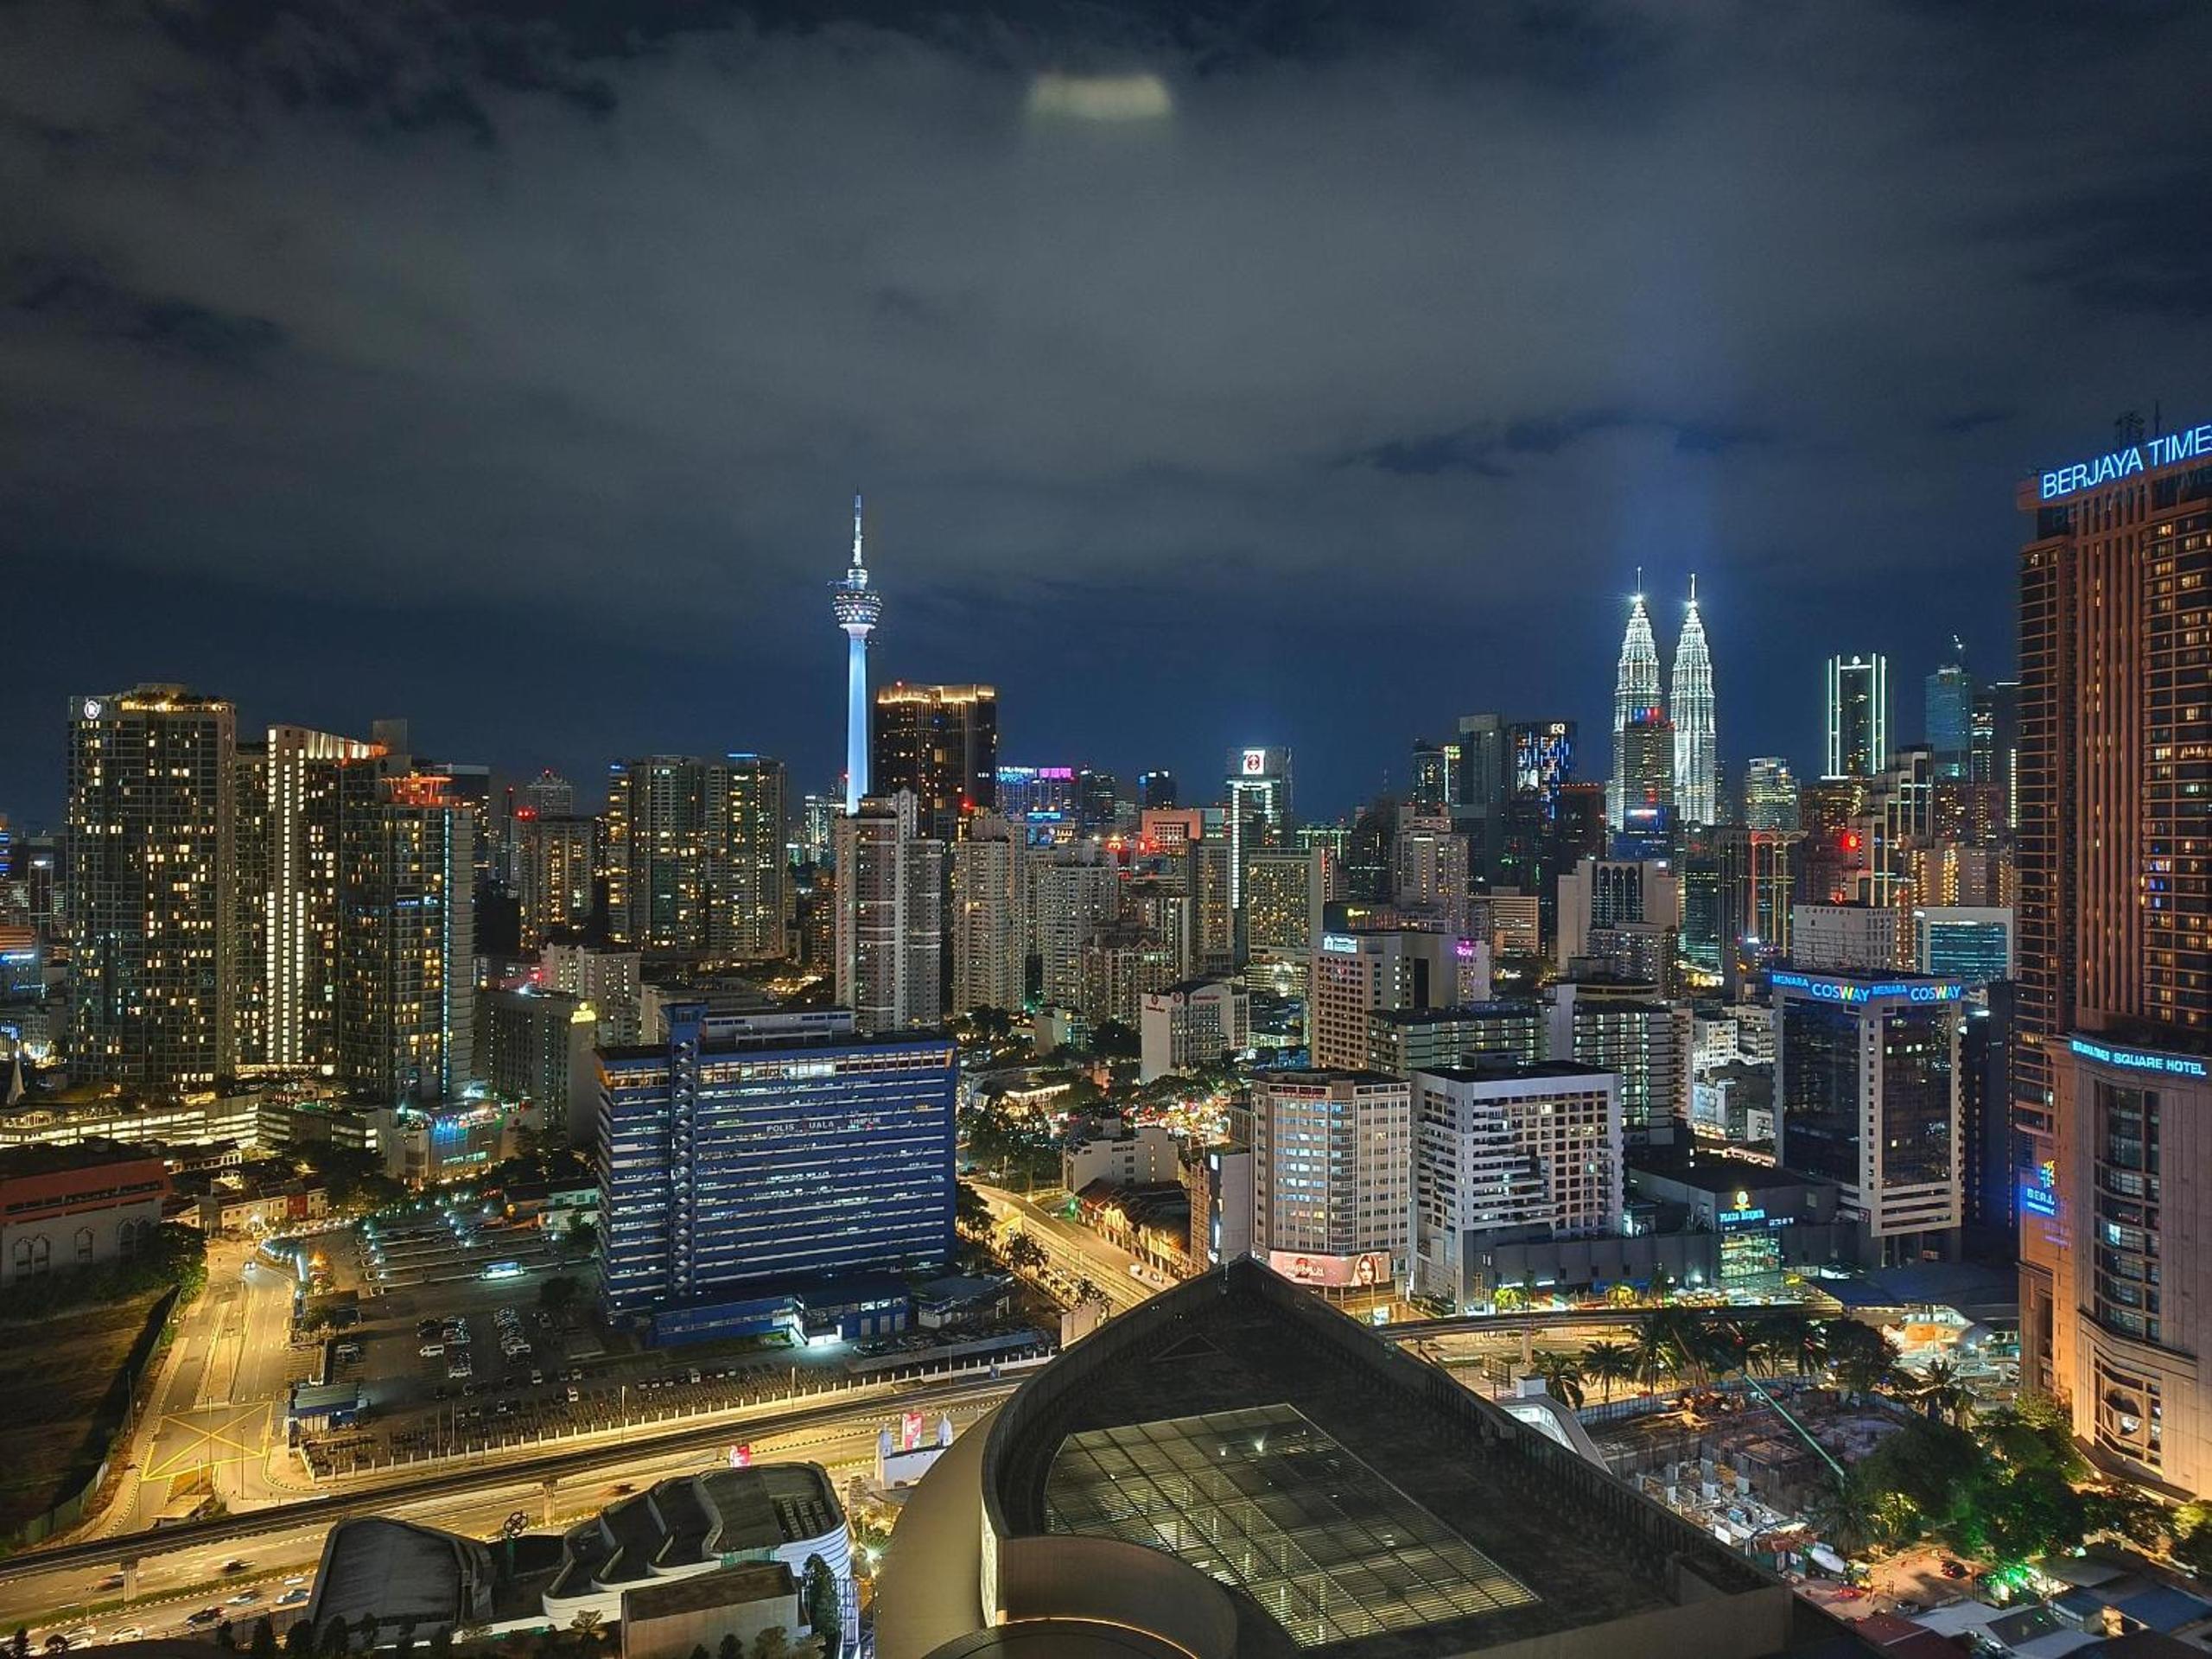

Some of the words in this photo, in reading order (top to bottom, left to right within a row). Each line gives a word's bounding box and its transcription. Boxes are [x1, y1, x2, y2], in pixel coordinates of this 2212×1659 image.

[2043, 448, 2144, 499] BERJAYA
[2147, 425, 2212, 467] TIME
[1551, 723, 1566, 734] EQ
[1772, 974, 1808, 988] MENARA
[1811, 983, 1870, 1002] COSWAY
[1872, 984, 1907, 995] MENARA
[1910, 986, 1961, 1001] COSWAY
[2113, 1052, 2164, 1069] SQUARE
[2166, 1059, 2207, 1075] HOTEL
[766, 1123, 795, 1133] POLIS
